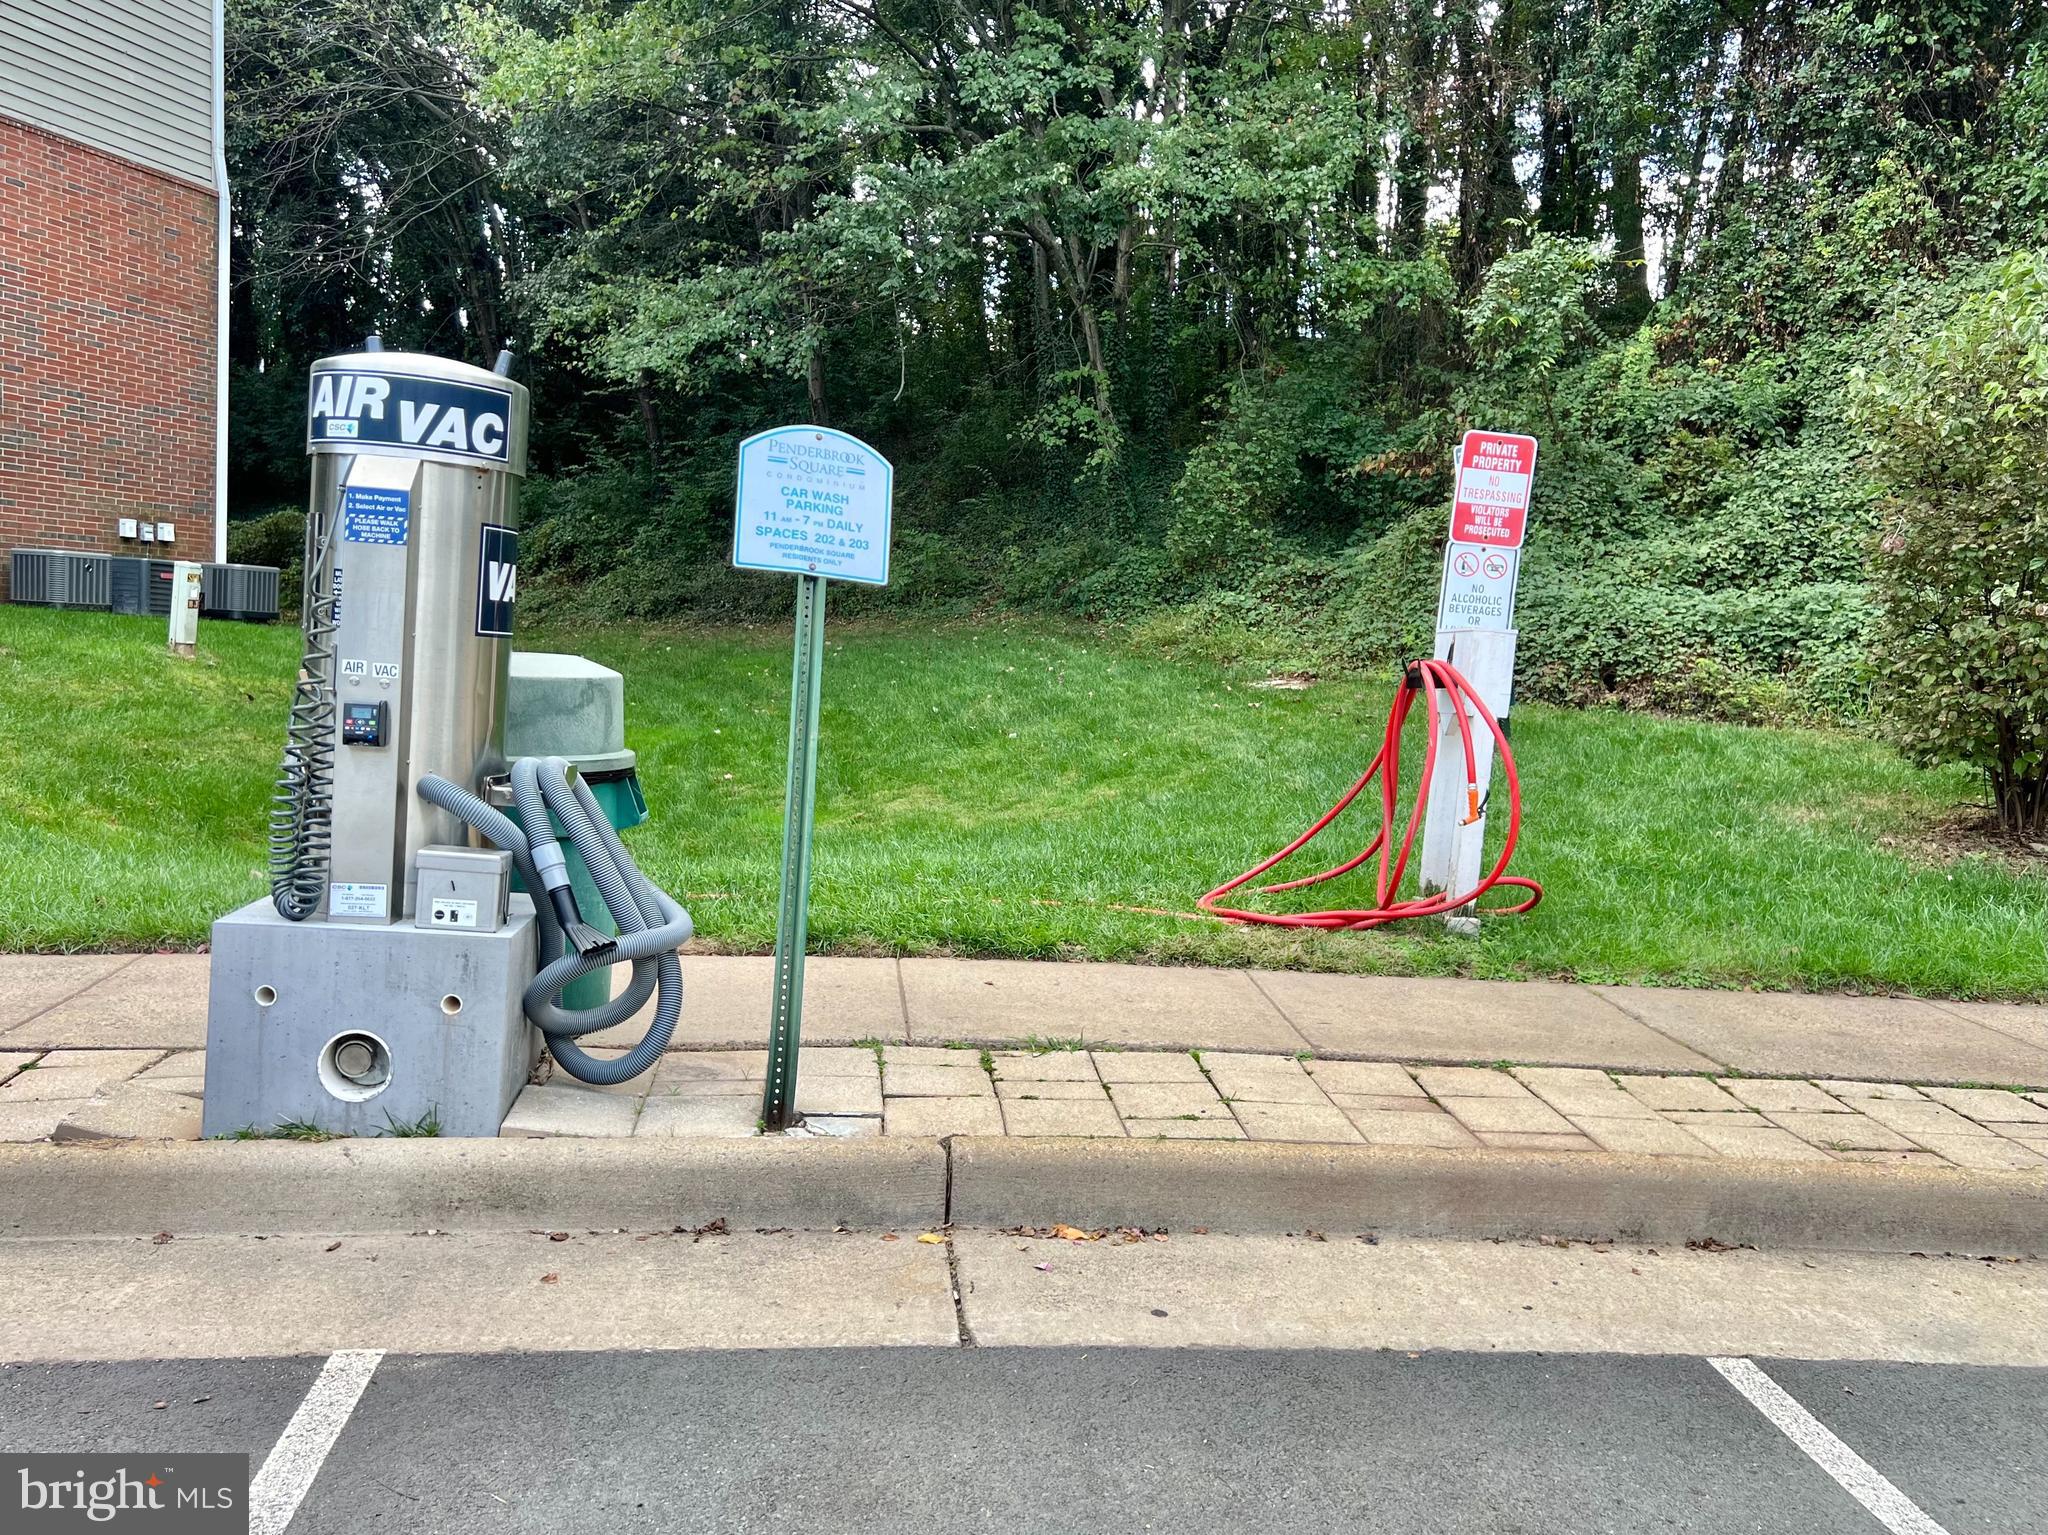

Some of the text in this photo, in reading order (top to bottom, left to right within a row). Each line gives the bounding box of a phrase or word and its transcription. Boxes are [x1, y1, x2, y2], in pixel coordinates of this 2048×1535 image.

[313, 375, 504, 454] AIR VAC
[328, 423, 346, 431] CSC
[768, 439, 865, 466] PENDERBROOK
[1480, 441, 1518, 458] PRIVATE
[789, 456, 845, 477] SQUARE
[1472, 455, 1522, 472] PROPERTY
[766, 470, 866, 490] CONDOMINIUM
[1488, 475, 1500, 487] NO
[374, 494, 401, 503] Payment
[781, 486, 849, 504] CAR WASH
[1463, 487, 1522, 503] TRESPASSING
[394, 505, 406, 513] Vac
[786, 499, 843, 516] PARKING
[1471, 505, 1510, 518] VIOLATORS
[352, 524, 371, 532] HOSE
[764, 511, 777, 521] 11
[802, 515, 810, 525] 7
[827, 519, 863, 533] DAILY
[1475, 514, 1503, 527] WILL BE
[361, 532, 391, 540] MACHINE
[755, 525, 869, 550] SPACES 202 & 203
[1464, 524, 1510, 538] PROSECUTED
[769, 542, 855, 560] PENDERBROOK SQUARE
[782, 552, 842, 567] RESIDENTS ONLY
[1471, 584, 1485, 593] NO
[1451, 593, 1502, 606] ALCOHOLIC
[1448, 603, 1502, 617] BEVERAGES
[1468, 616, 1480, 625] OR
[344, 661, 397, 677] AIR VAC
